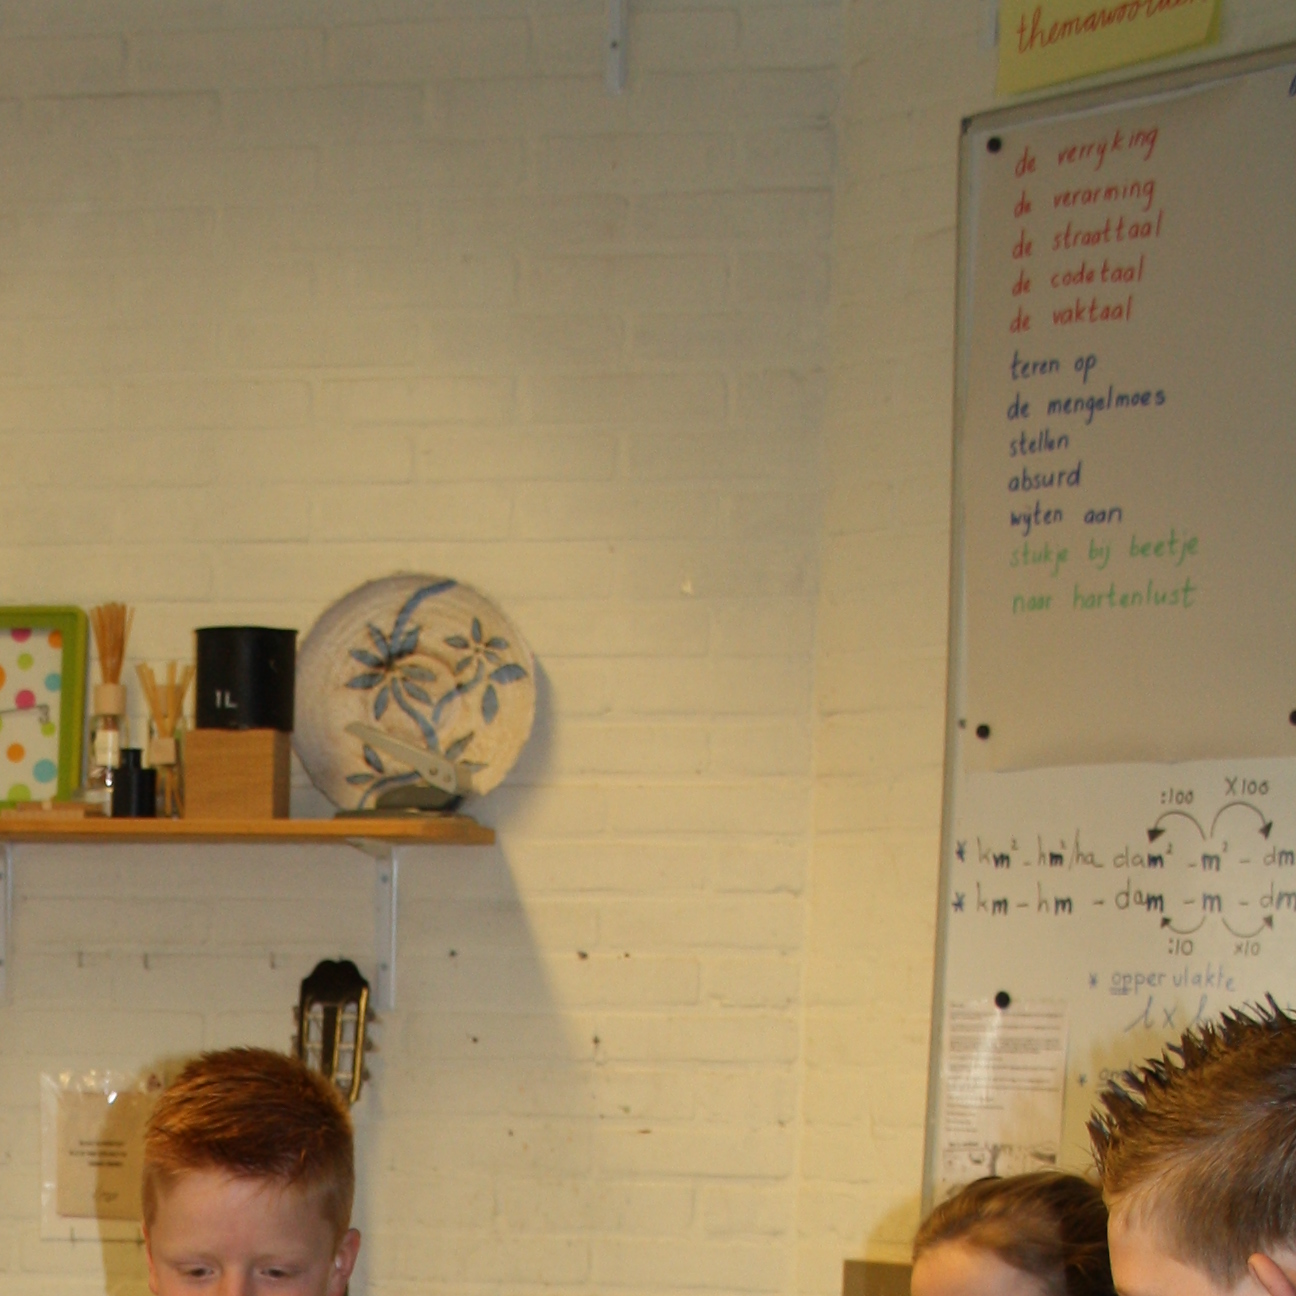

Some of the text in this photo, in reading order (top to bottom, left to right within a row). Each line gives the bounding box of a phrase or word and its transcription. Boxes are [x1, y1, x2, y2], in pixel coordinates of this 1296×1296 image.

[1015, 146, 1036, 178] de
[1014, 180, 1155, 218] de verarming
[1012, 208, 1164, 260] de straattaal
[1012, 254, 1145, 297] de codetaal
[1009, 295, 1134, 334] de vaktaal
[1010, 350, 1098, 384] teren op
[1007, 385, 1167, 426] de mengelmoes
[1009, 428, 1070, 457] stellen
[1008, 460, 1083, 492] absurd
[1084, 506, 1123, 524] aan
[1129, 528, 1200, 567] beetje
